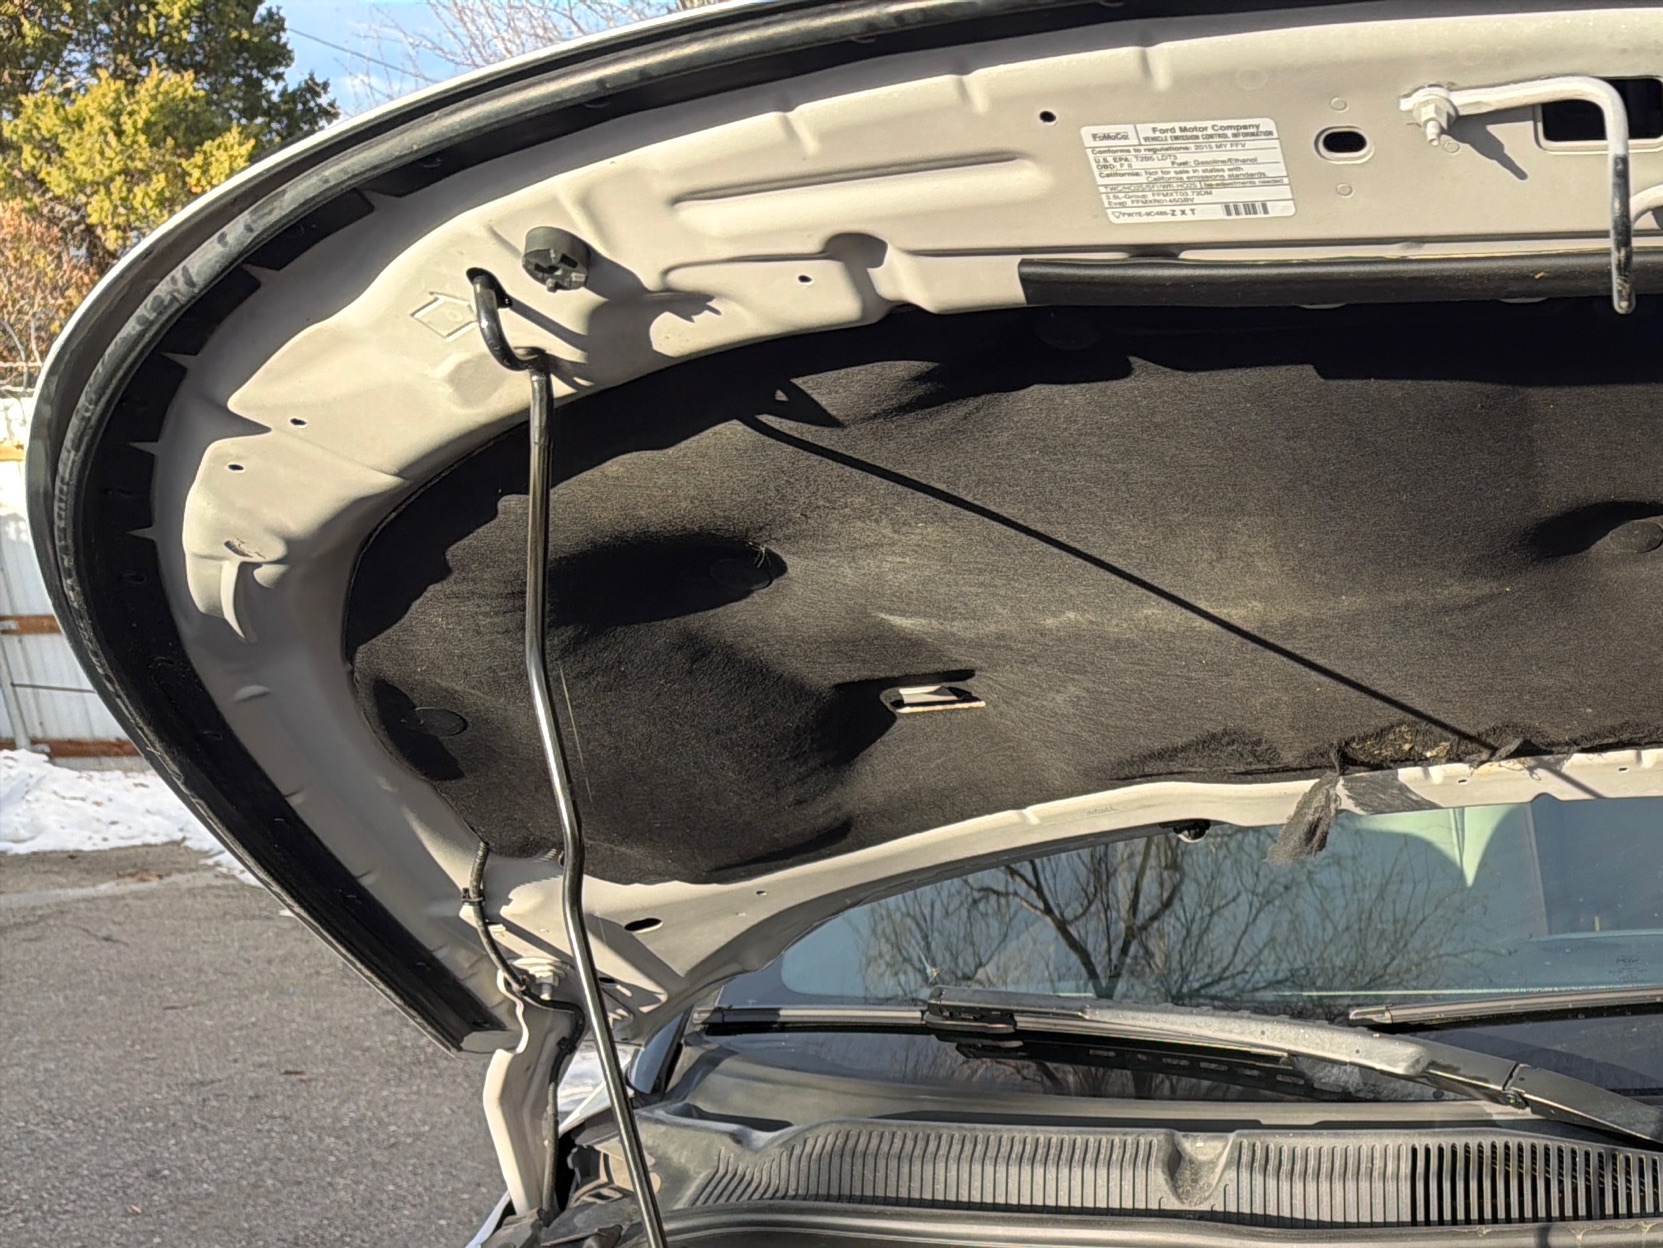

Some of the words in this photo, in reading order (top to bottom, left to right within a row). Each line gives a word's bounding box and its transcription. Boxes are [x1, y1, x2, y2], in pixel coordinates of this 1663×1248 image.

[1179, 125, 1209, 133] Motor
[1211, 123, 1261, 133] Company
[1201, 132, 1230, 140] CONTROL
[1231, 130, 1274, 138] INFORMATION
[1146, 175, 1184, 183] California
